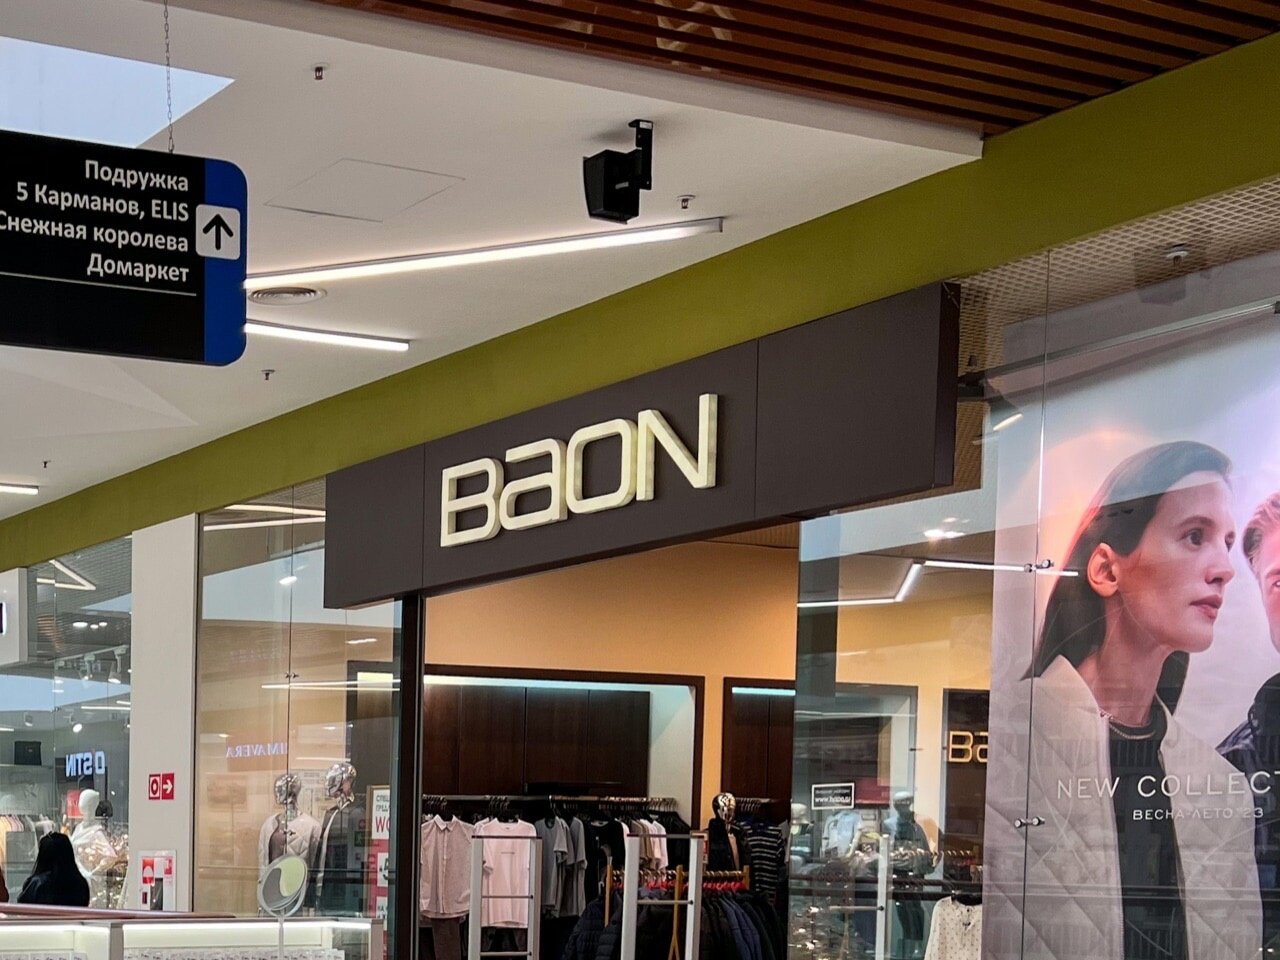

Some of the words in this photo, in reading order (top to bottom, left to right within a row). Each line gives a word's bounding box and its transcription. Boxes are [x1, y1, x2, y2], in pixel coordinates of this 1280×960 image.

[85, 160, 189, 192] Подружка
[16, 182, 28, 202] 5
[34, 183, 146, 220] Карманов,
[151, 199, 189, 222] ELIS
[93, 221, 189, 253] королева
[87, 252, 189, 283] Домаркет
[1057, 777, 1120, 799] NEW
